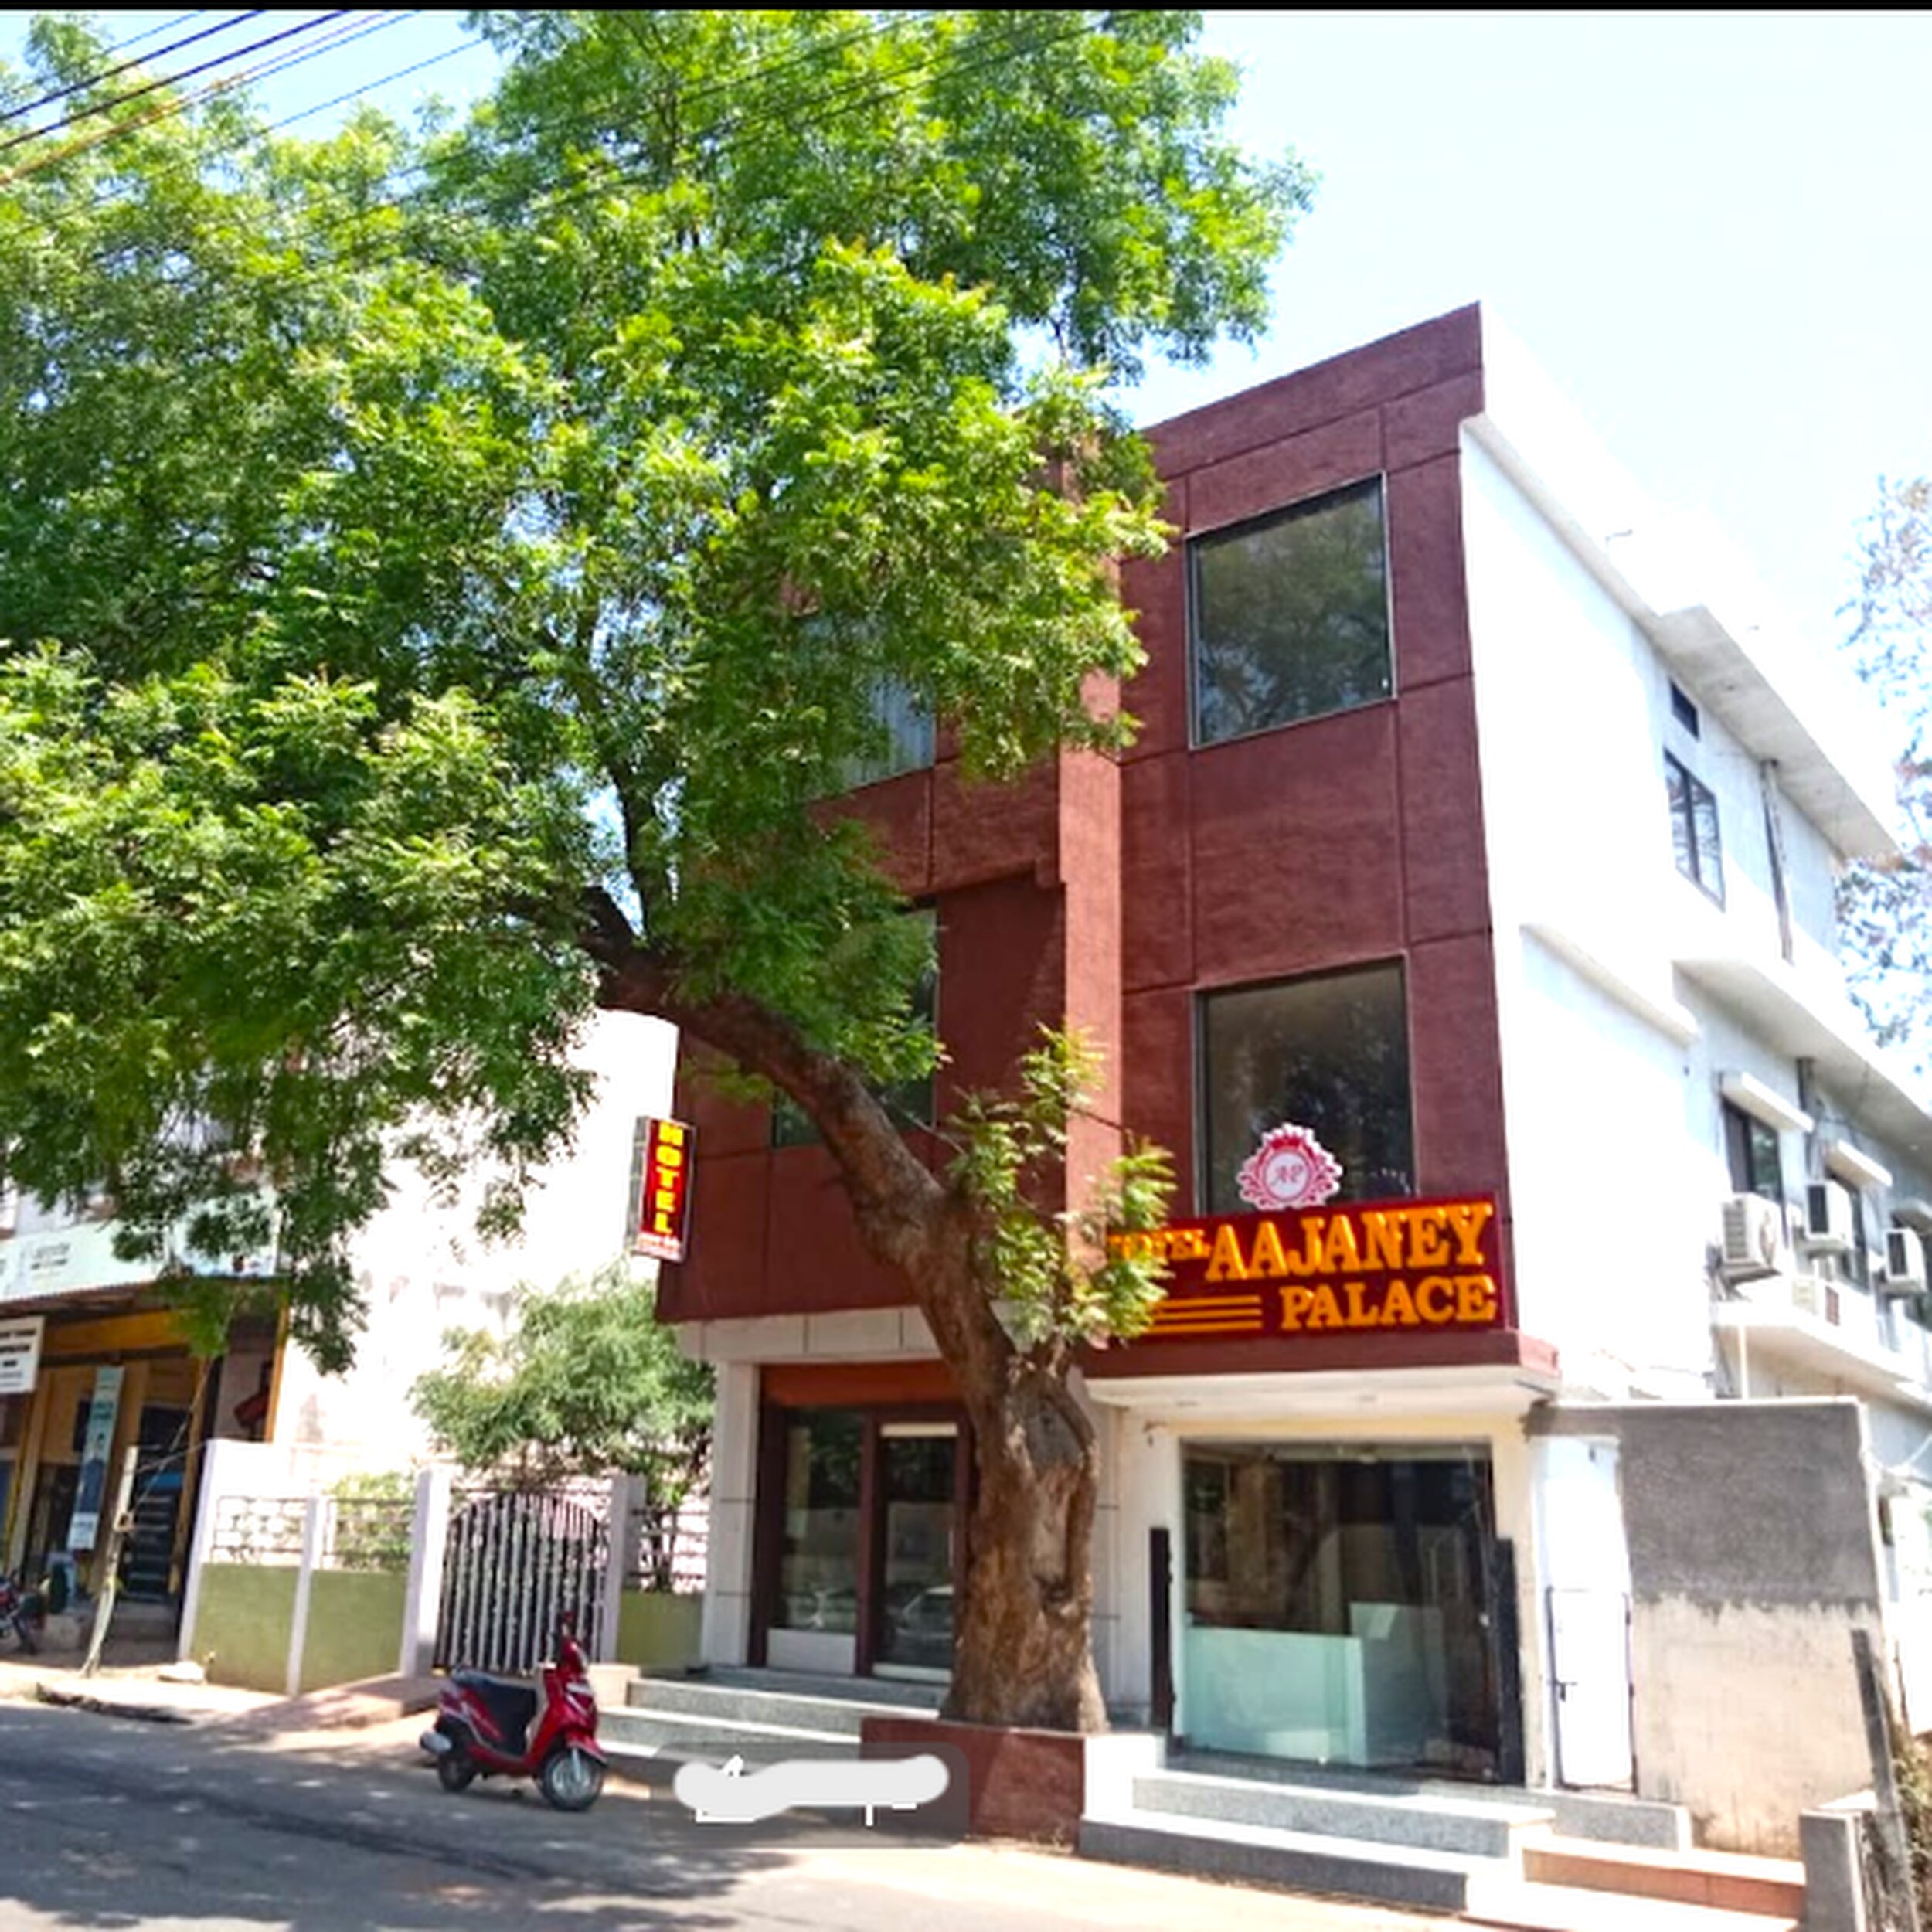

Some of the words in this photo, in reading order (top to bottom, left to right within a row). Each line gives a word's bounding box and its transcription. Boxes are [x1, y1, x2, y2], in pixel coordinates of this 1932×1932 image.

[655, 1121, 684, 1235] HOTEL
[1206, 1202, 1493, 1281] AAJANEY
[1279, 1276, 1496, 1330] PALACE
